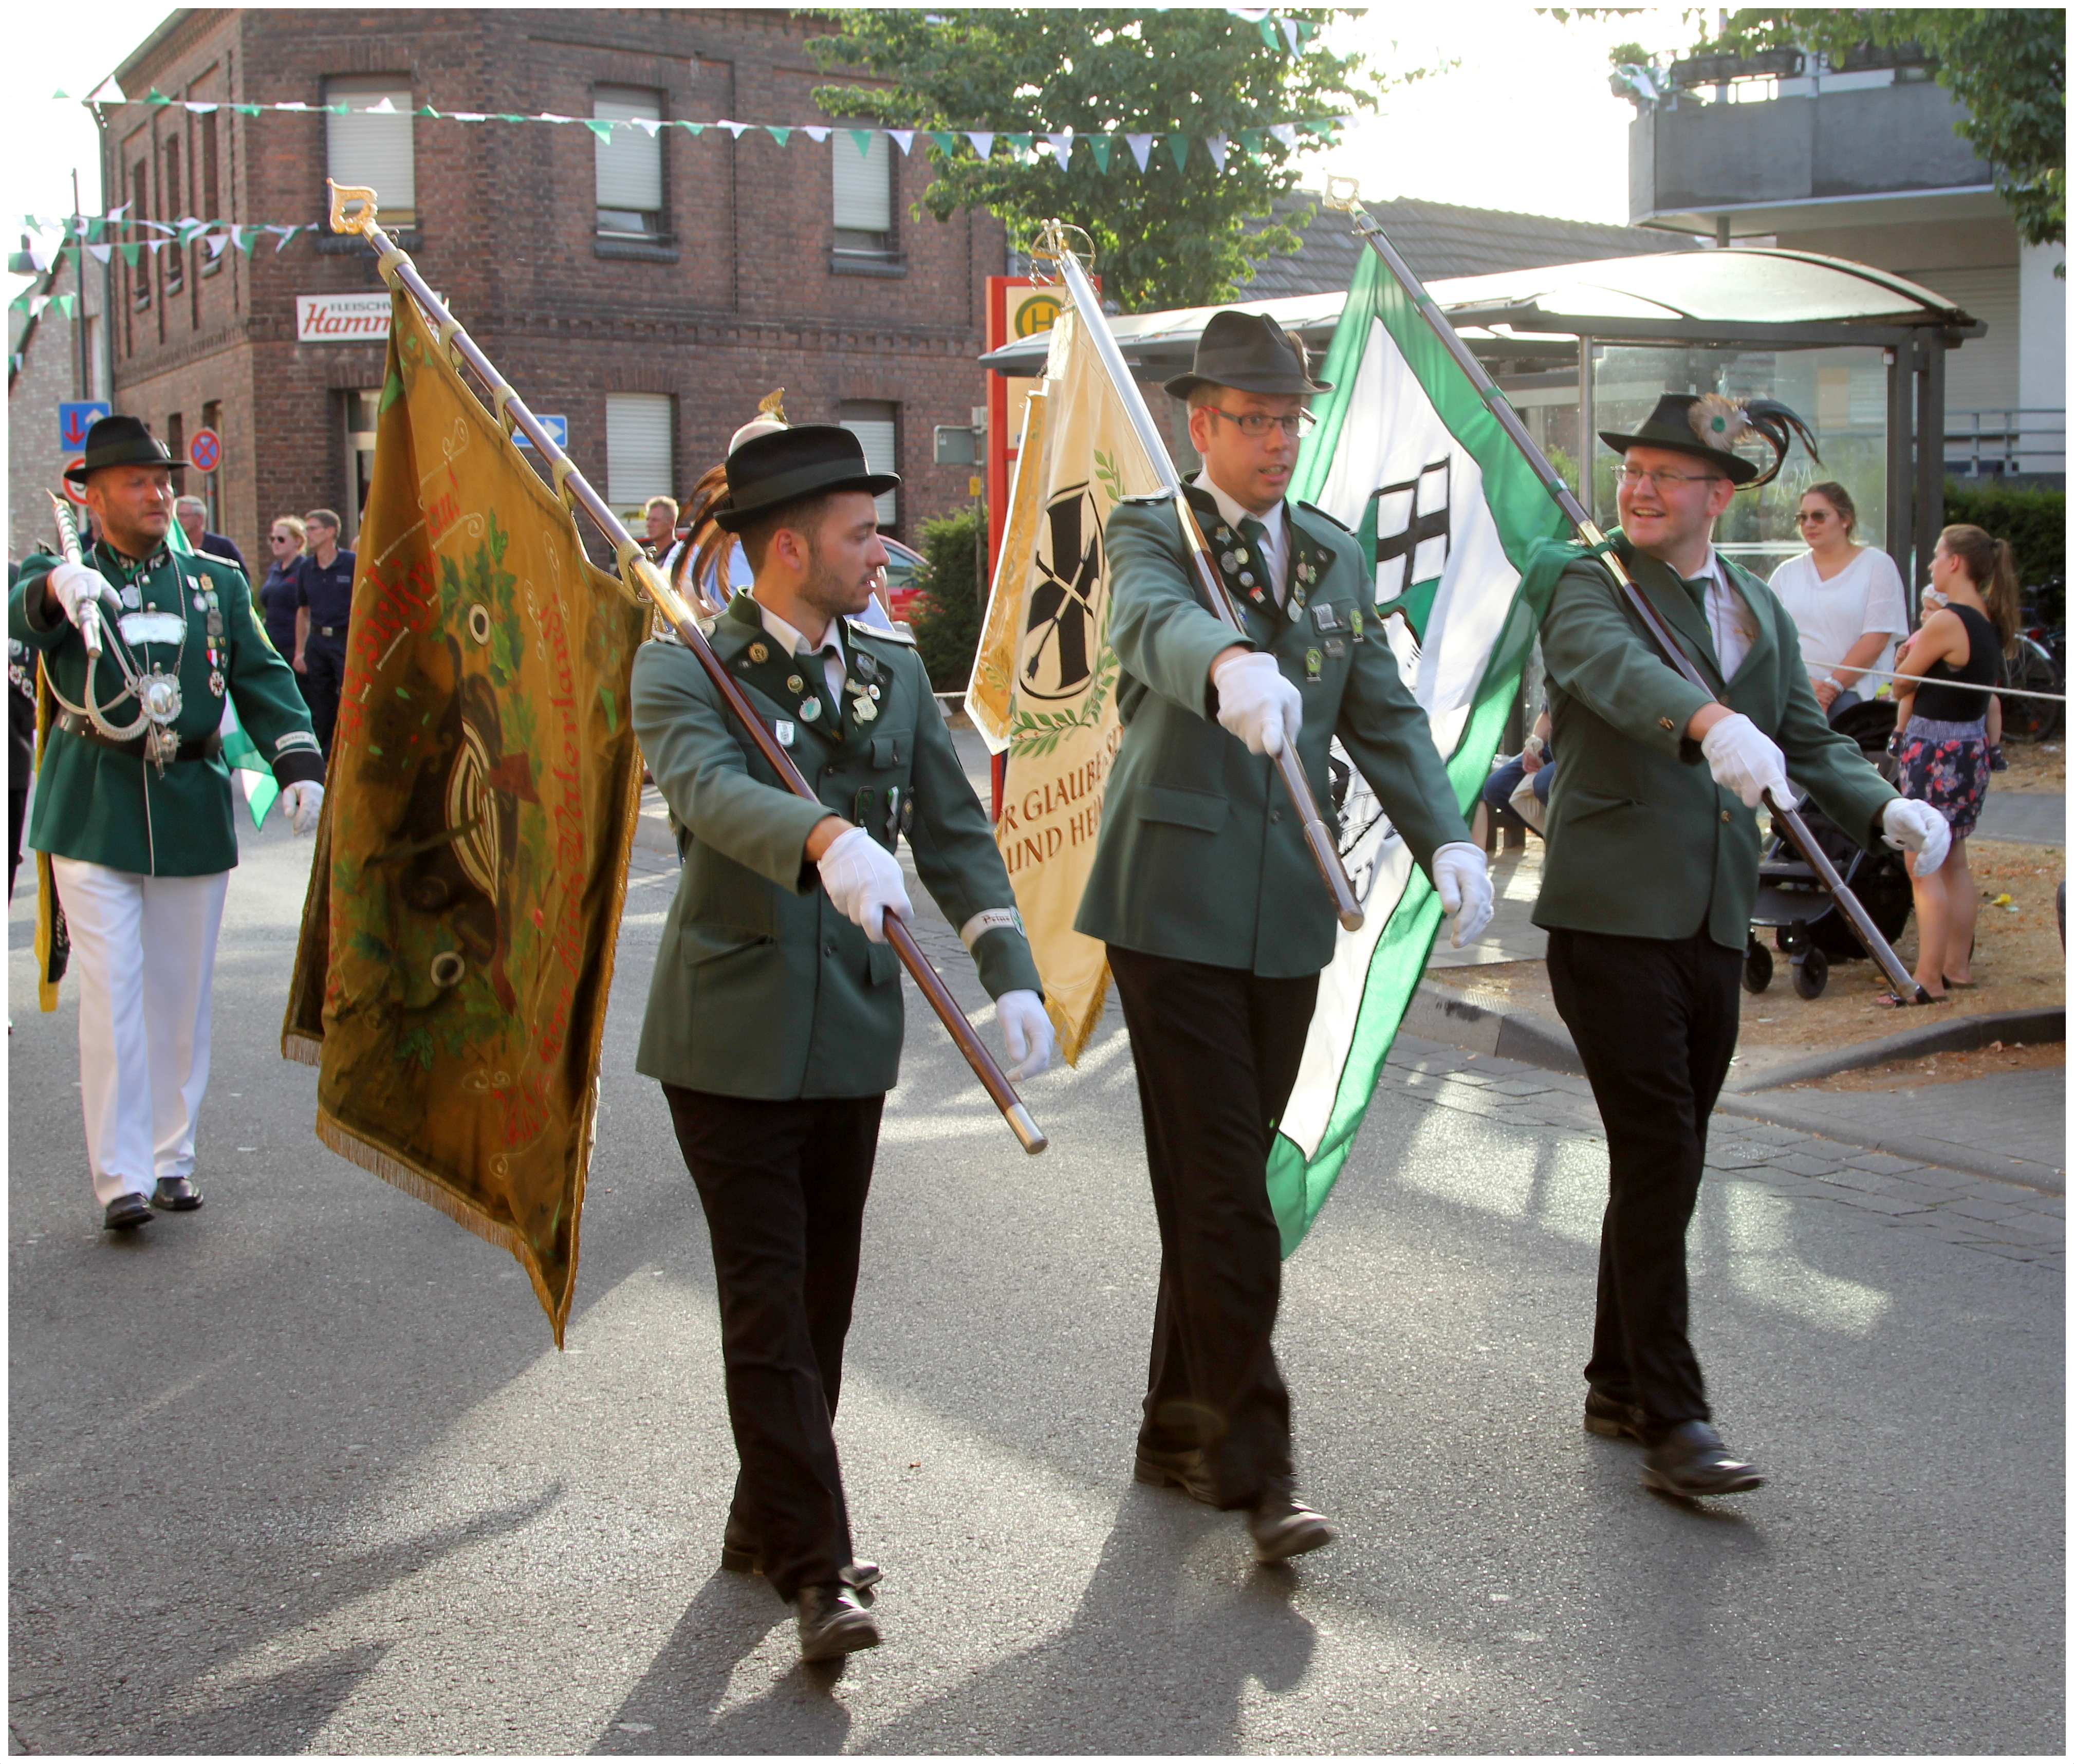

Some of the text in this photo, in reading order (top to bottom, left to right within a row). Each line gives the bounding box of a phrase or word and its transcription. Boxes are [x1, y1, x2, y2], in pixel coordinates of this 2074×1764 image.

[303, 303, 391, 334] Hamm
[1032, 307, 1053, 333] H
[1006, 825, 1063, 875] UND
